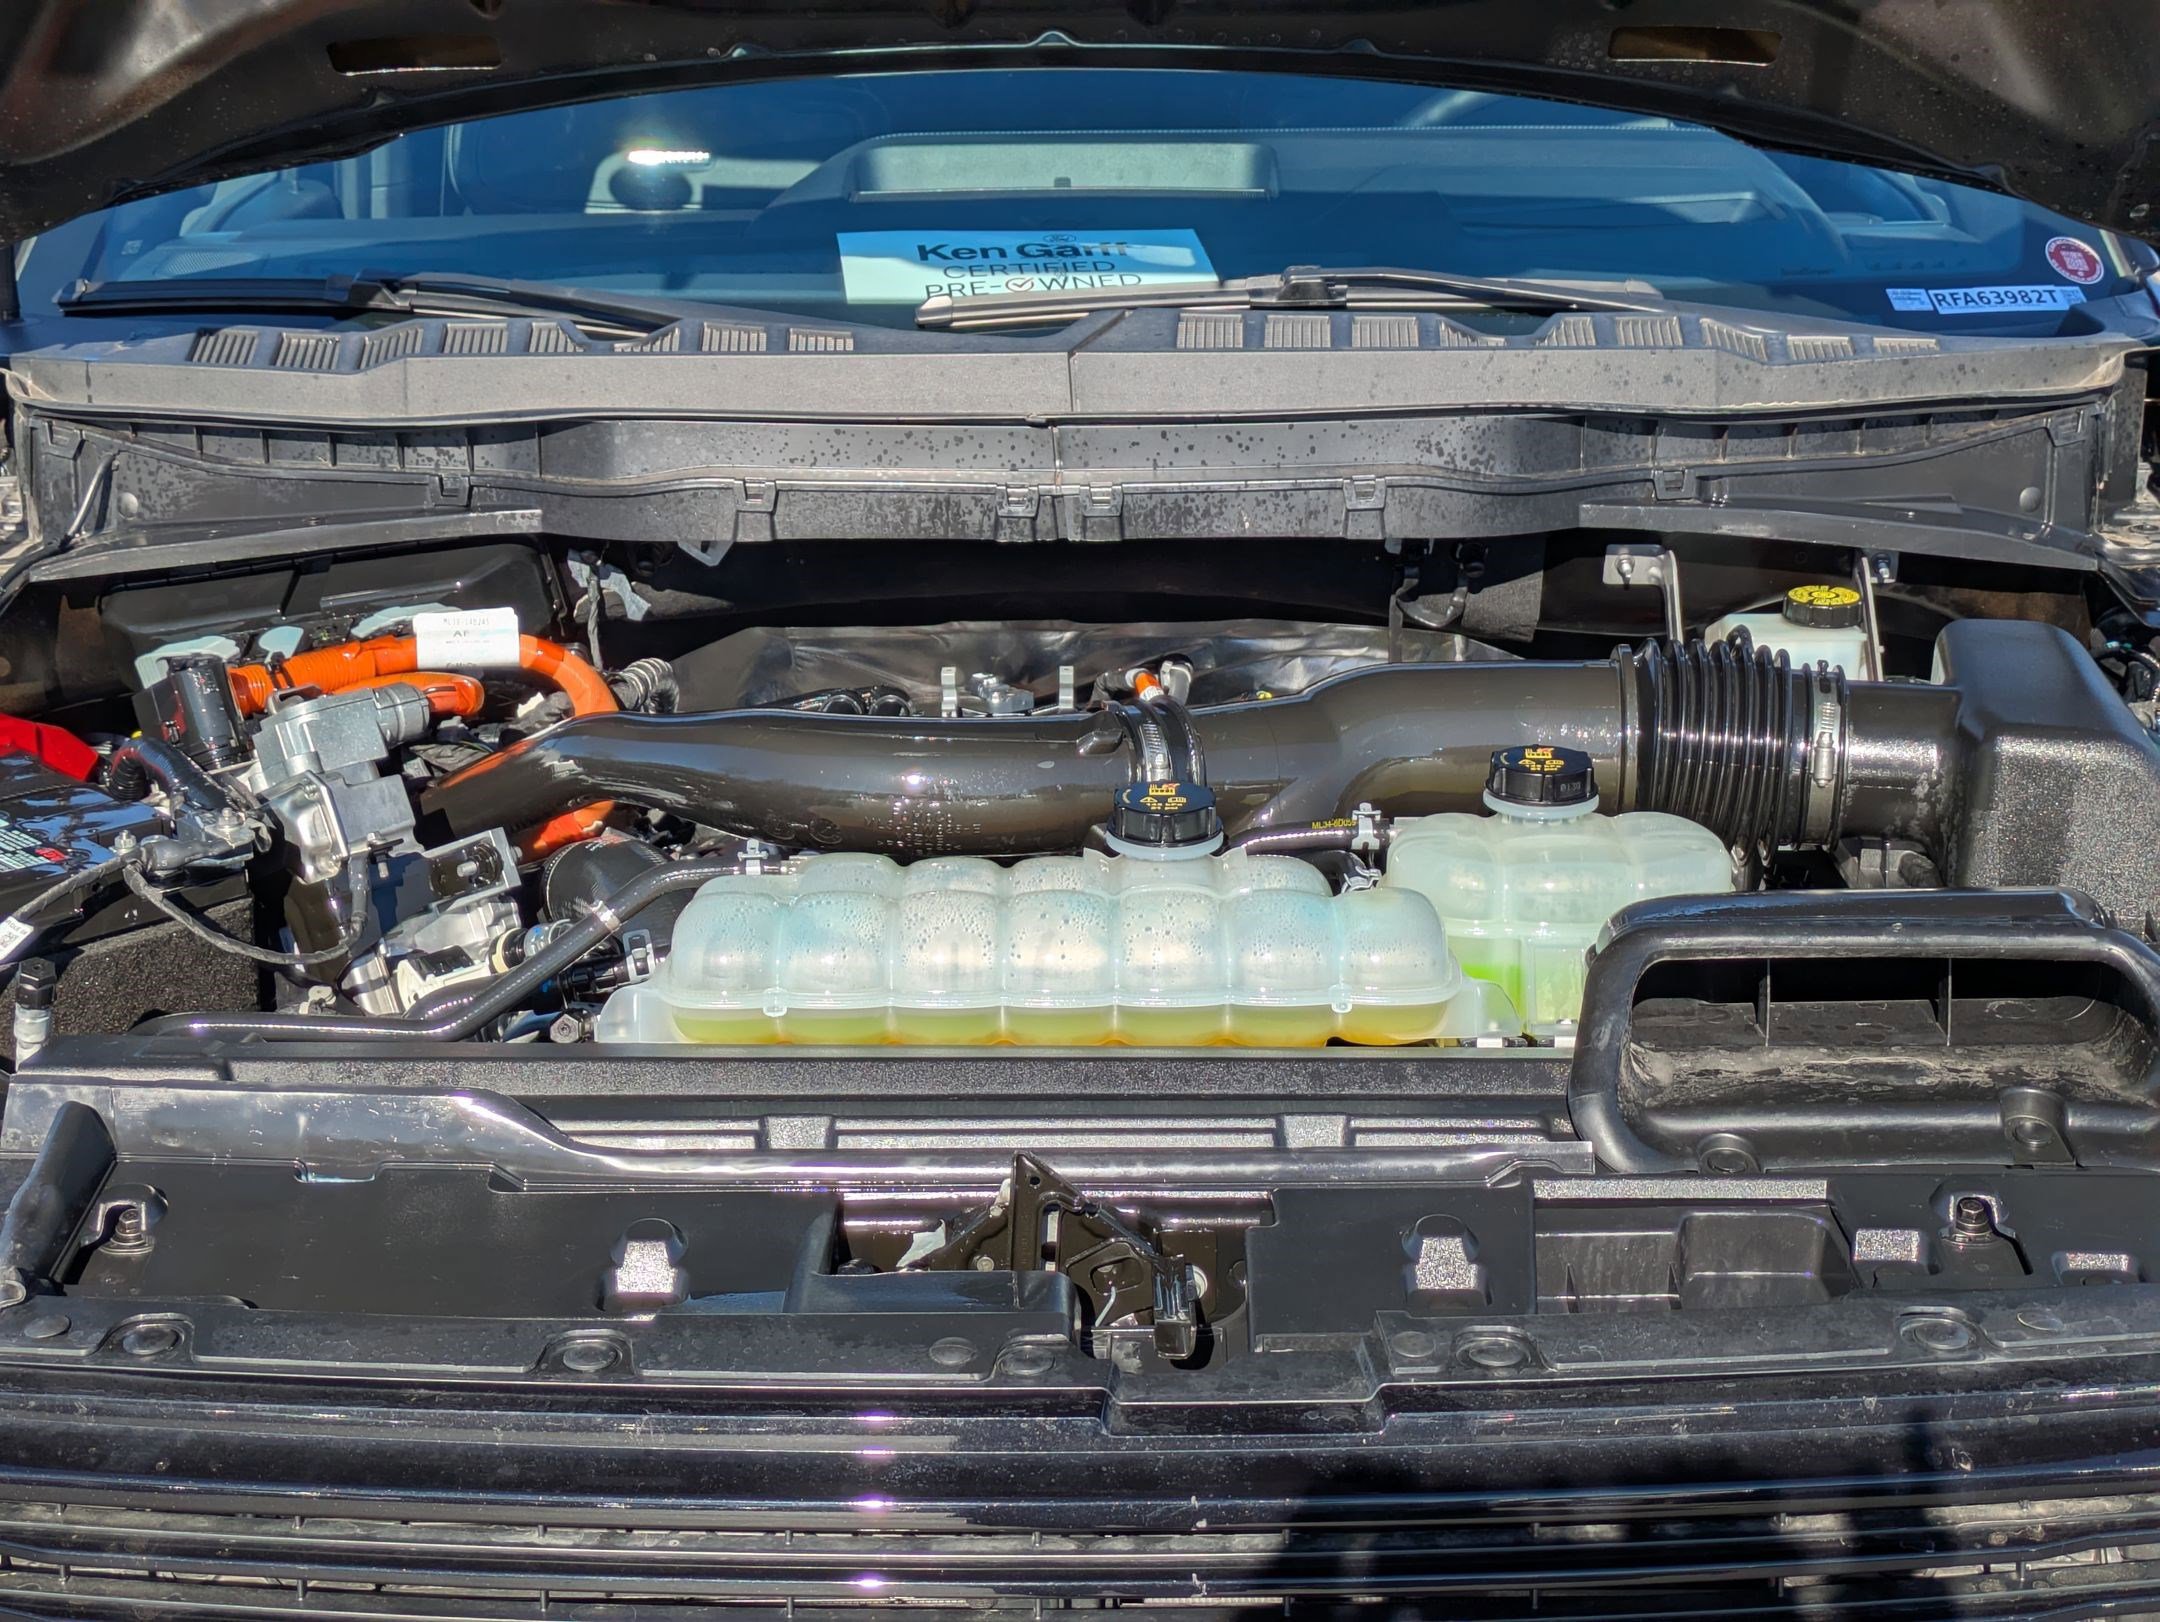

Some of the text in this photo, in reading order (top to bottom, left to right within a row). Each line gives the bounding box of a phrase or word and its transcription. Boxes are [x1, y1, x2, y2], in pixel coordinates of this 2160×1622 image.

[917, 242, 1008, 262] Ken
[943, 260, 1116, 280] CERTIFIED
[1933, 288, 2058, 308] RFA63982T
